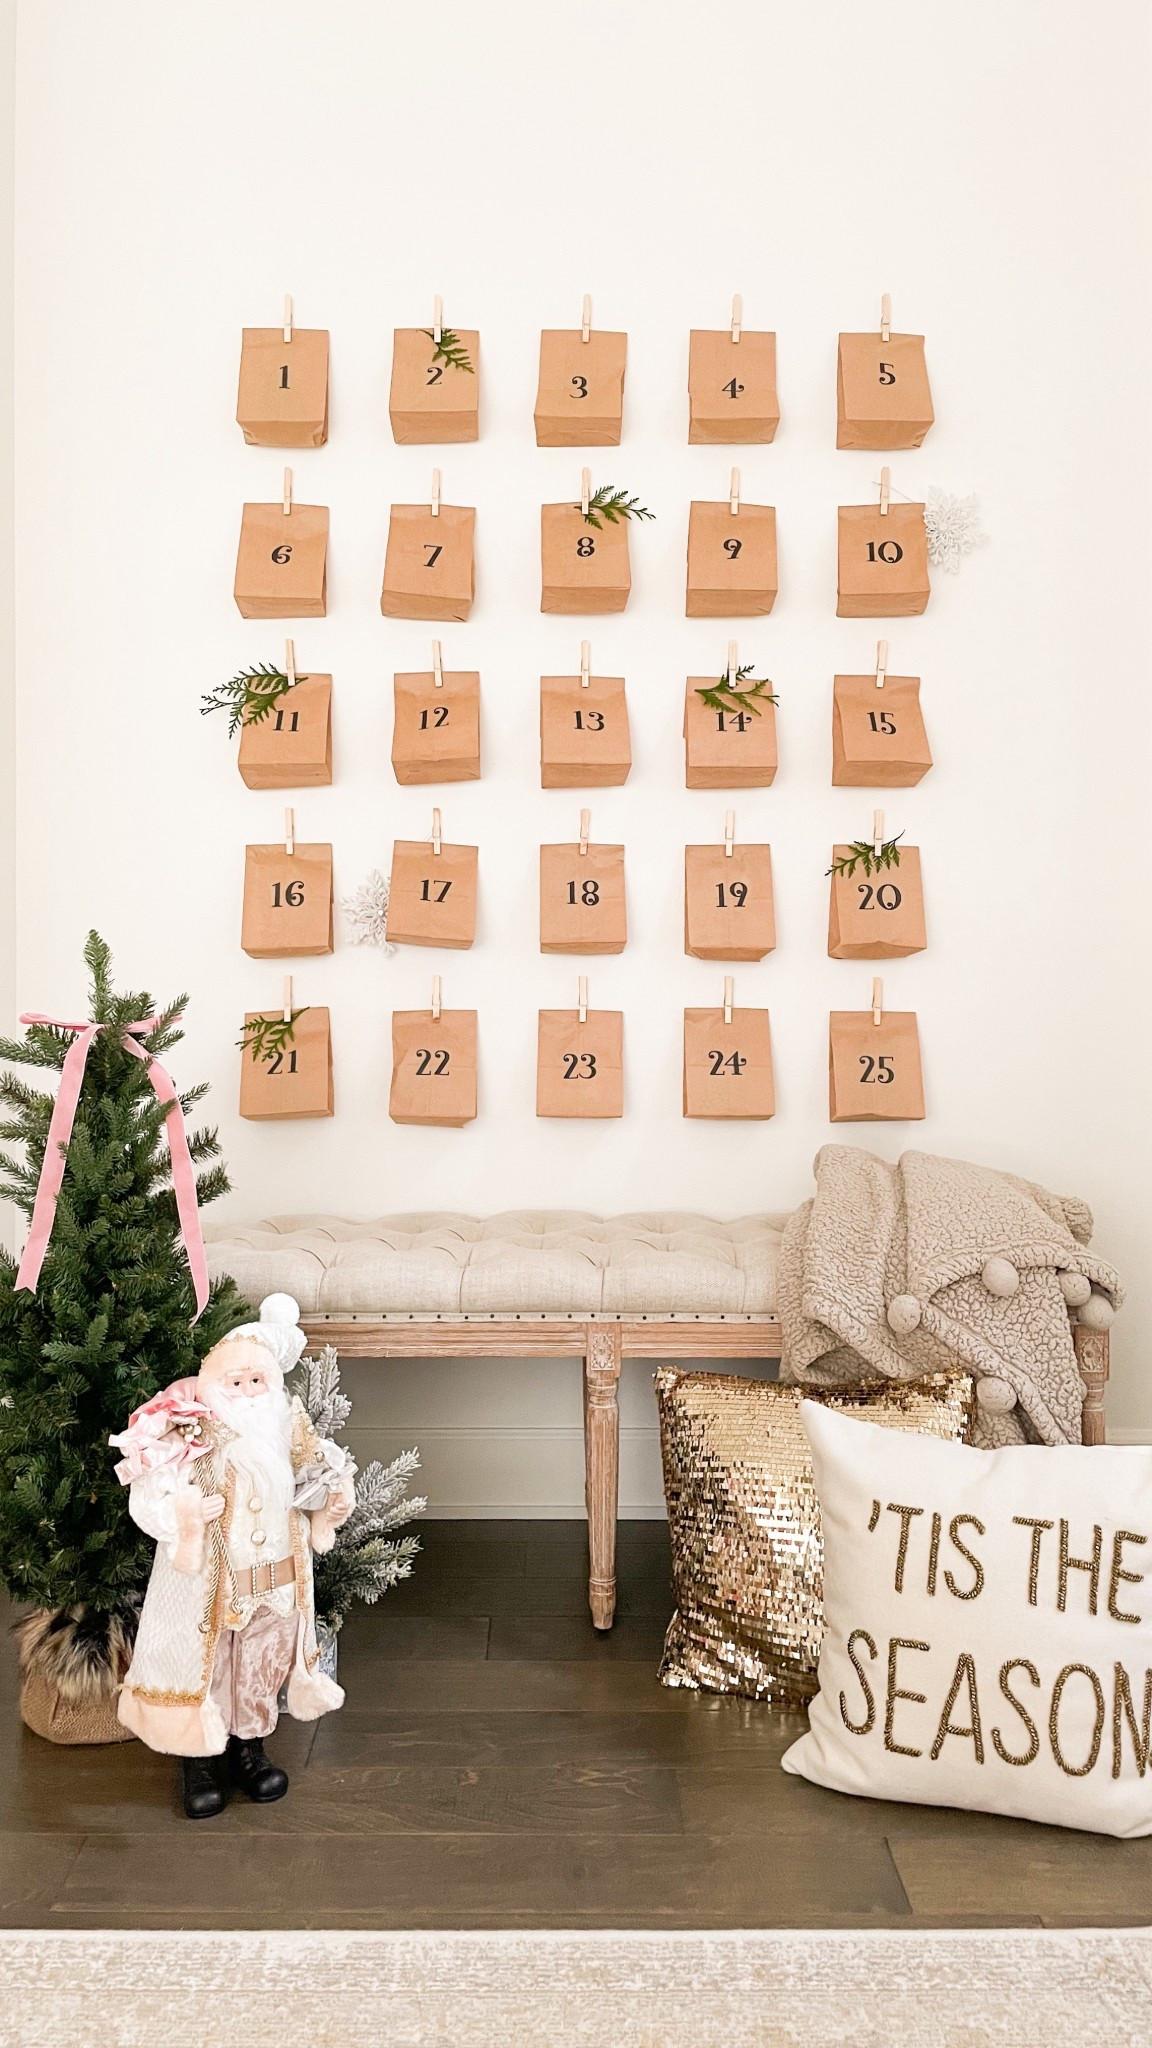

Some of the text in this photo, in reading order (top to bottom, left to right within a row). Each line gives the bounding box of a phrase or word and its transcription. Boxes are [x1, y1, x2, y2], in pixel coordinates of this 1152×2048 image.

[278, 365, 290, 390] 1
[426, 367, 443, 385] 2
[879, 362, 896, 385] 5
[570, 375, 588, 399] 3
[721, 377, 745, 399] 4
[271, 545, 293, 565] 6
[424, 545, 443, 568] 7
[576, 536, 595, 558] 8
[723, 538, 742, 560] 9
[865, 541, 903, 564] 10
[272, 709, 299, 732] 11
[418, 706, 449, 730] 12
[575, 710, 605, 731] 13
[716, 710, 753, 732] 14
[867, 711, 897, 735] 15
[271, 880, 305, 908] 16
[420, 879, 453, 903] 17
[567, 880, 600, 906] 18
[716, 882, 748, 908] 19
[857, 883, 902, 911] 20
[267, 1049, 297, 1075] 21
[415, 1049, 450, 1076] 22
[563, 1053, 597, 1080] 23
[708, 1050, 747, 1076] 24
[859, 1055, 895, 1084] 25
[868, 1500, 1148, 1624] 'TIS THE
[839, 1629, 1152, 1779] SEASON
